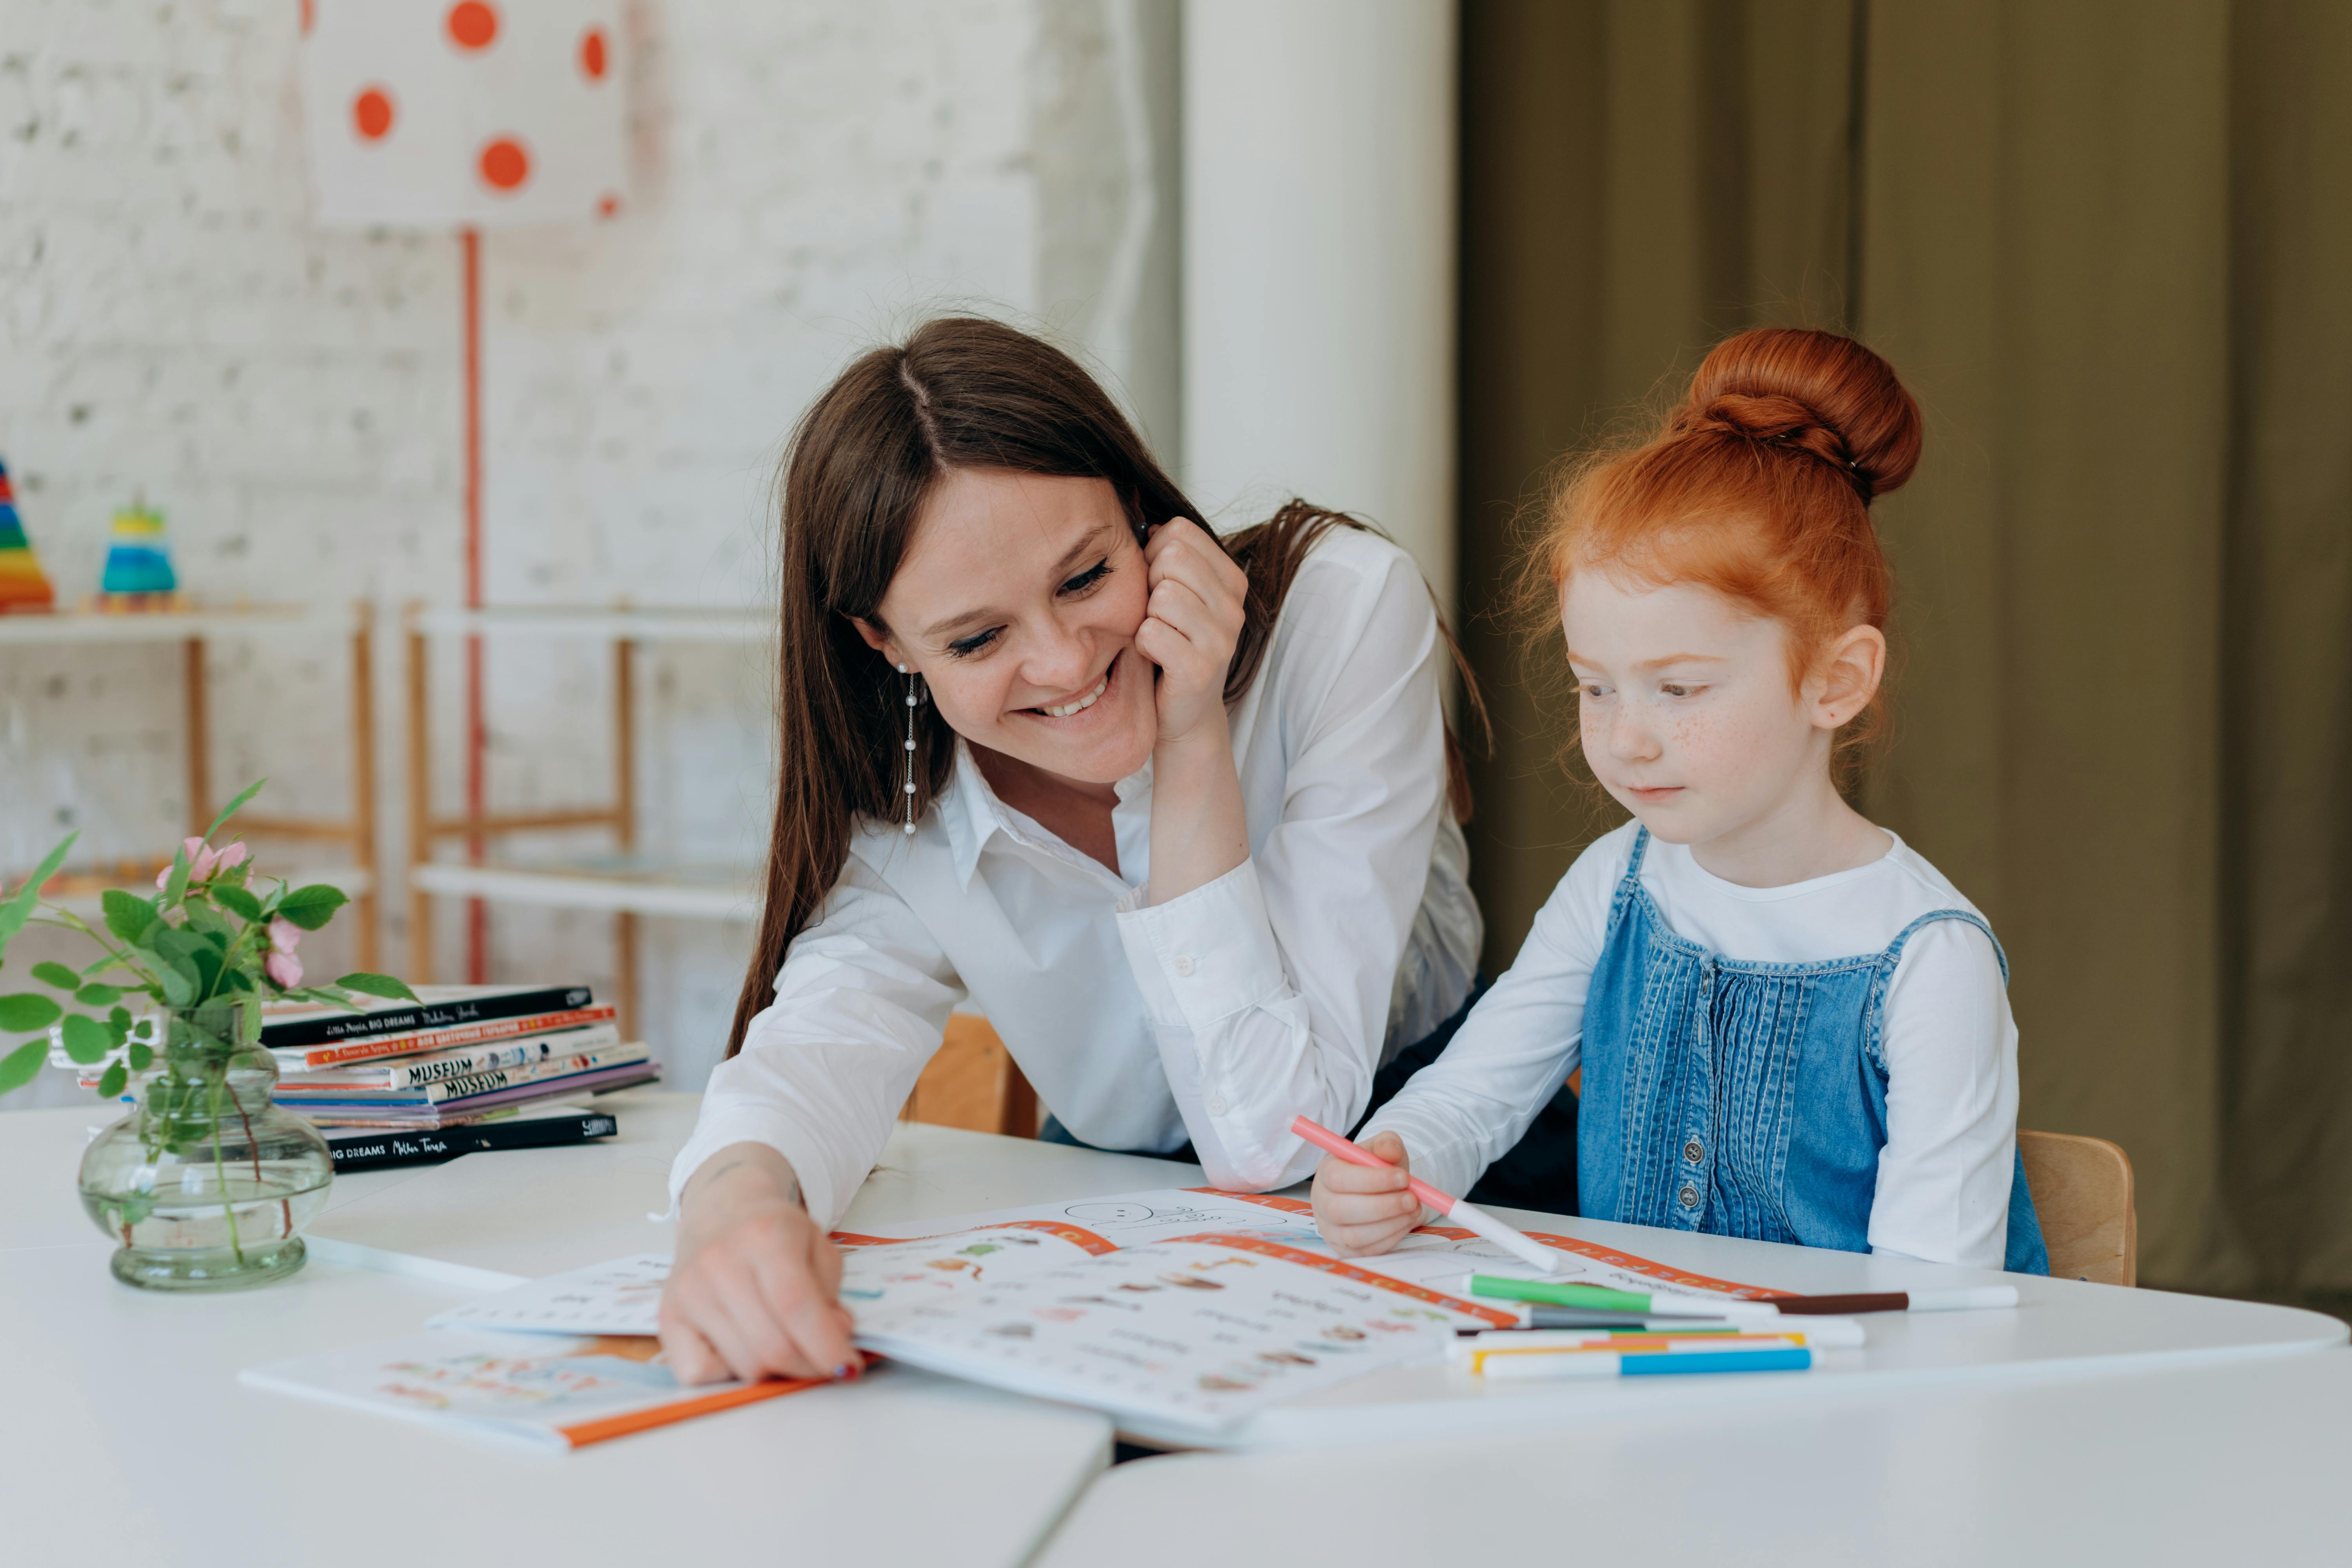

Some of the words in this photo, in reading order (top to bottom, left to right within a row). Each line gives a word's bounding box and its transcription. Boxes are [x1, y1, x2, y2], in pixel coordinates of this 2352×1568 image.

[327, 1025, 344, 1036] Little
[369, 1019, 383, 1030] BIG
[384, 1014, 415, 1028] DREAMS
[408, 1057, 472, 1084] MUSEUM
[444, 1071, 508, 1098] MUSEUM
[346, 1145, 385, 1158] DREAMS
